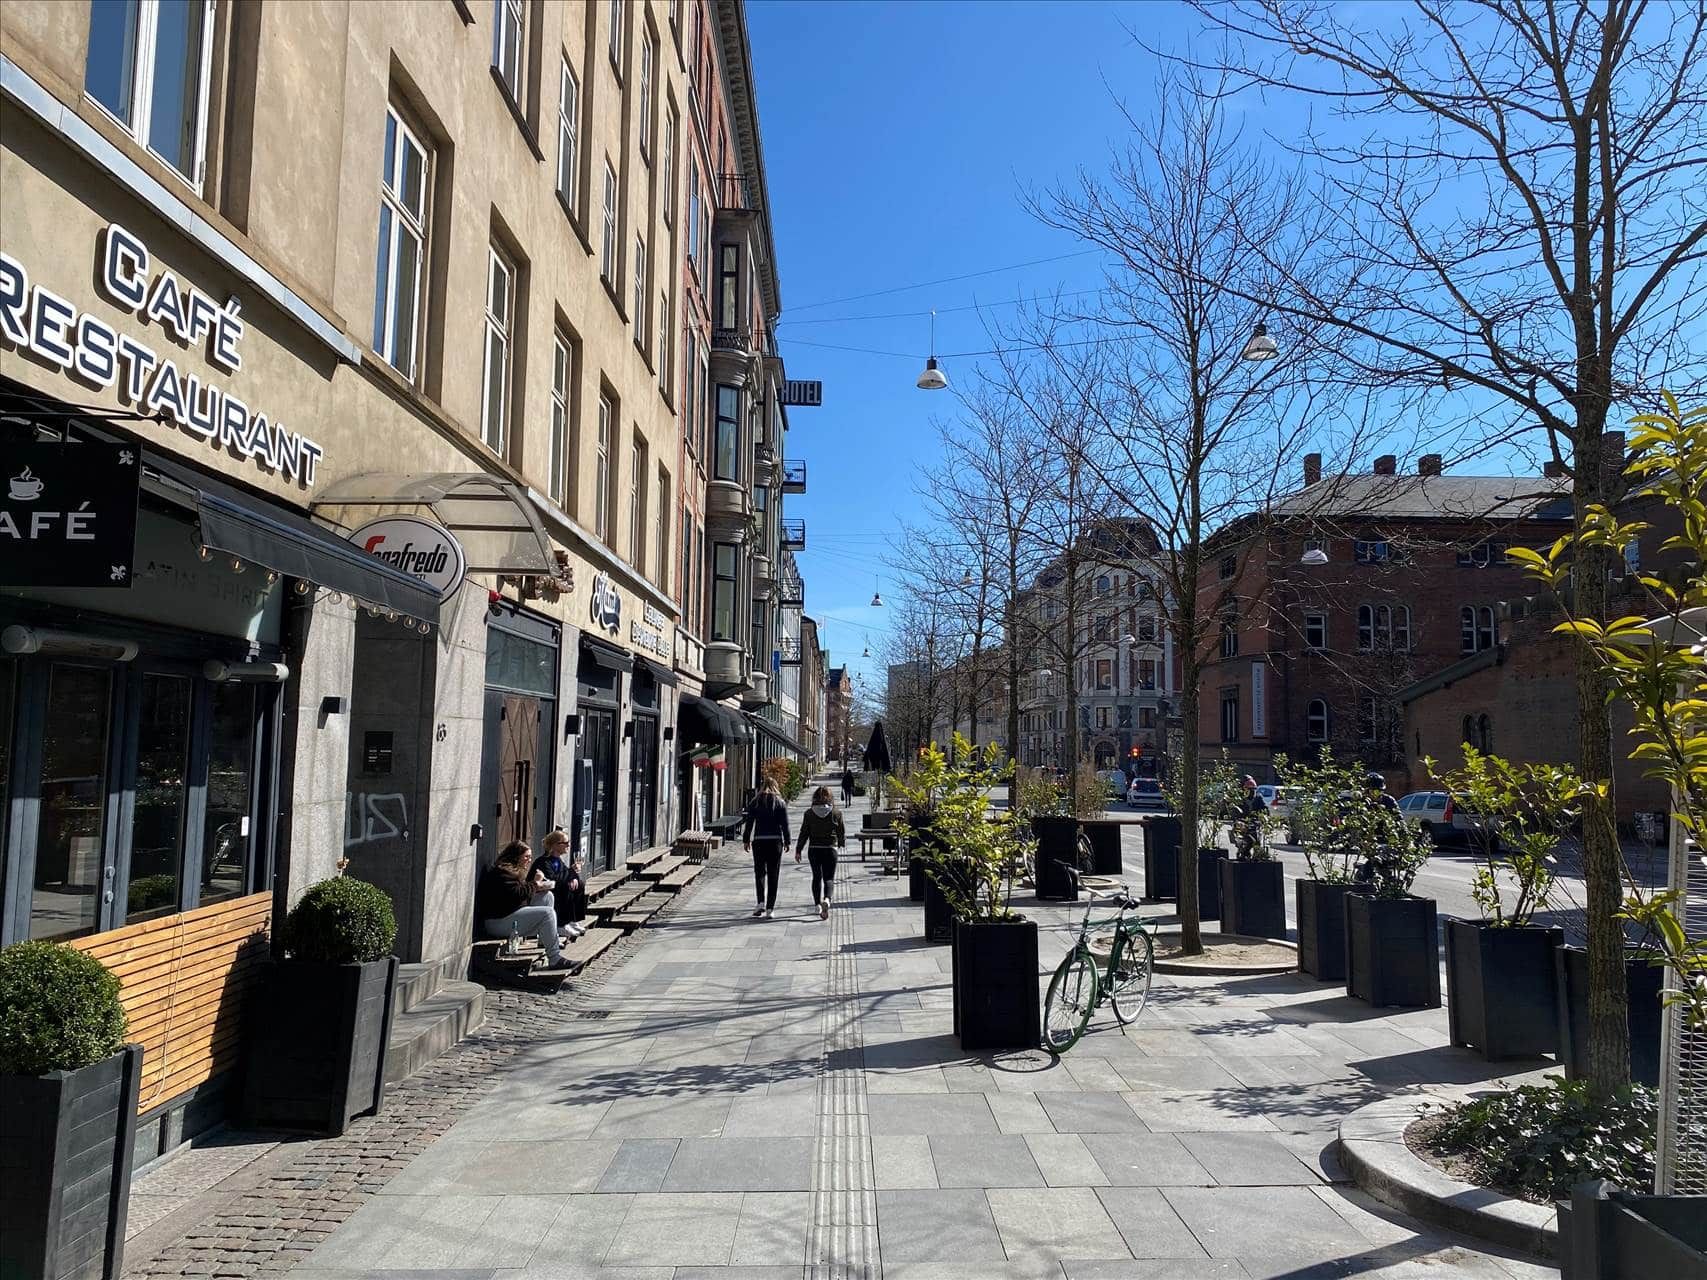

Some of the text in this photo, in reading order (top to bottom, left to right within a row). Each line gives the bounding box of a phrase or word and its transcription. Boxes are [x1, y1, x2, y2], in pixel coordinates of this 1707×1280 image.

[0, 254, 324, 487] RESTAURANT
[104, 222, 243, 373] CAFÉ
[781, 380, 821, 404] HOTEL
